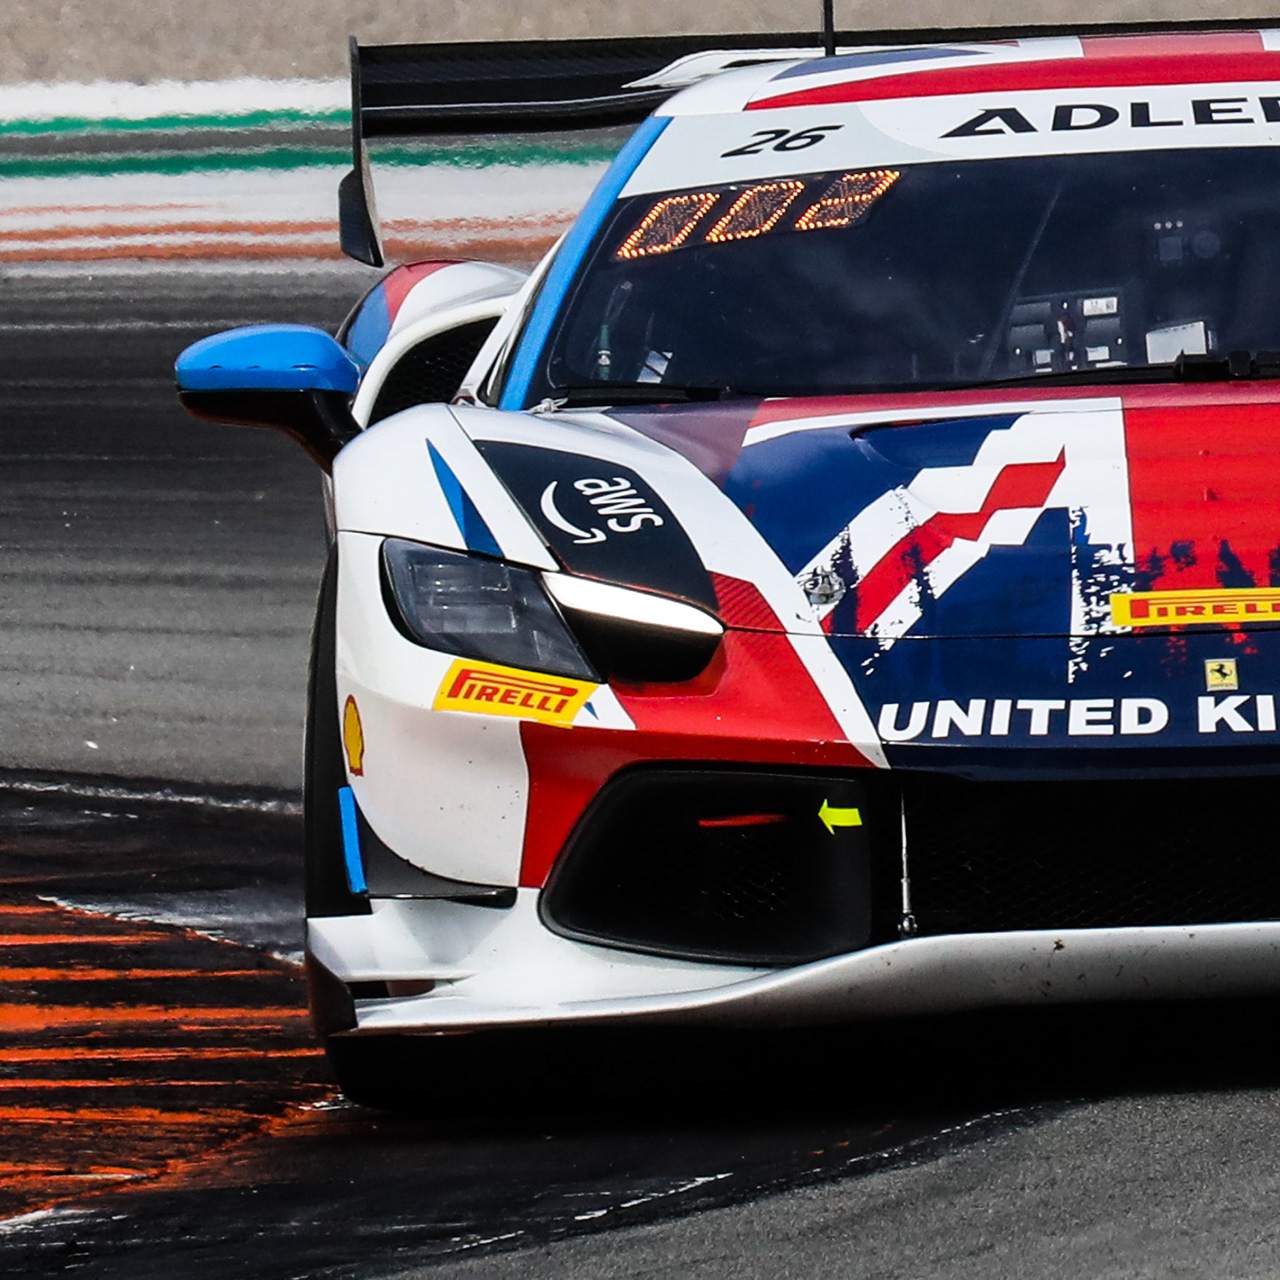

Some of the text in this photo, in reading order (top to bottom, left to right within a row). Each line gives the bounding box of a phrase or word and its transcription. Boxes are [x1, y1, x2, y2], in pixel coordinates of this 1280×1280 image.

[720, 124, 845, 158] 26
[616, 170, 901, 258] 002
[573, 477, 664, 533] aws
[447, 668, 578, 713] PIRELLI
[877, 696, 1170, 742] UNITED
